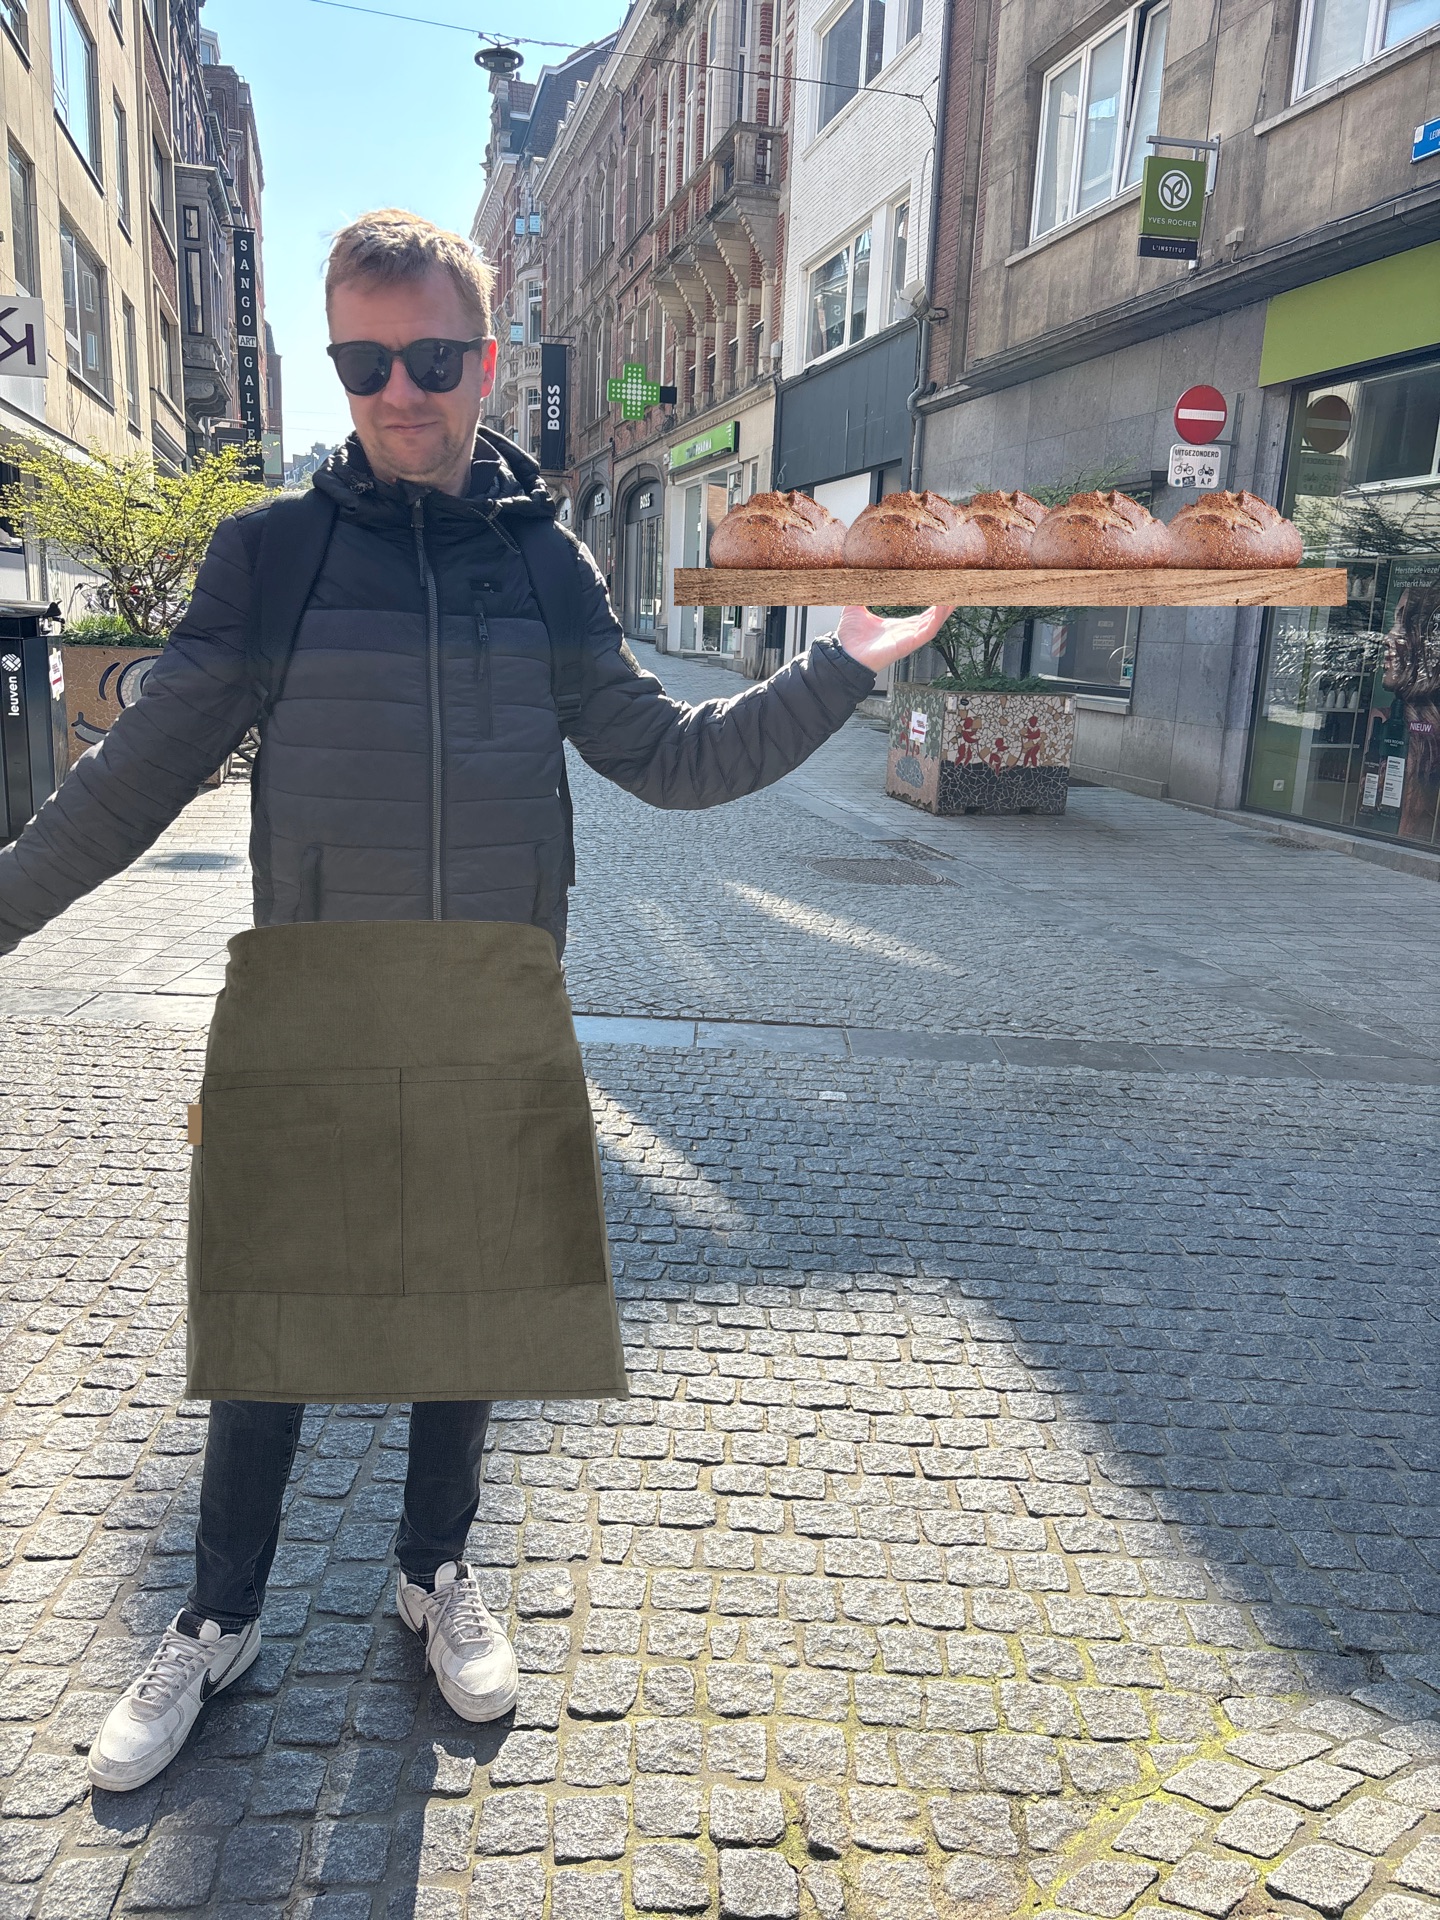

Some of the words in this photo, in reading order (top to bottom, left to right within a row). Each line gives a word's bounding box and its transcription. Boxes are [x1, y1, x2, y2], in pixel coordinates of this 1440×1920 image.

[1148, 217, 1166, 225] YVES
[1167, 218, 1197, 228] ROCHER
[1152, 244, 1187, 254] L'INSTITUT
[240, 239, 252, 327] SANGO
[240, 336, 256, 346] ART
[547, 384, 561, 431] BOSS
[1175, 449, 1220, 458] UITGEZONDERD
[640, 492, 652, 510] BOSS
[1395, 566, 1423, 575] Herstelde
[1393, 579, 1419, 588] Versterkt
[1419, 579, 1433, 588] haar
[8, 676, 20, 716] leuven
[1410, 722, 1432, 732] NIEUW
